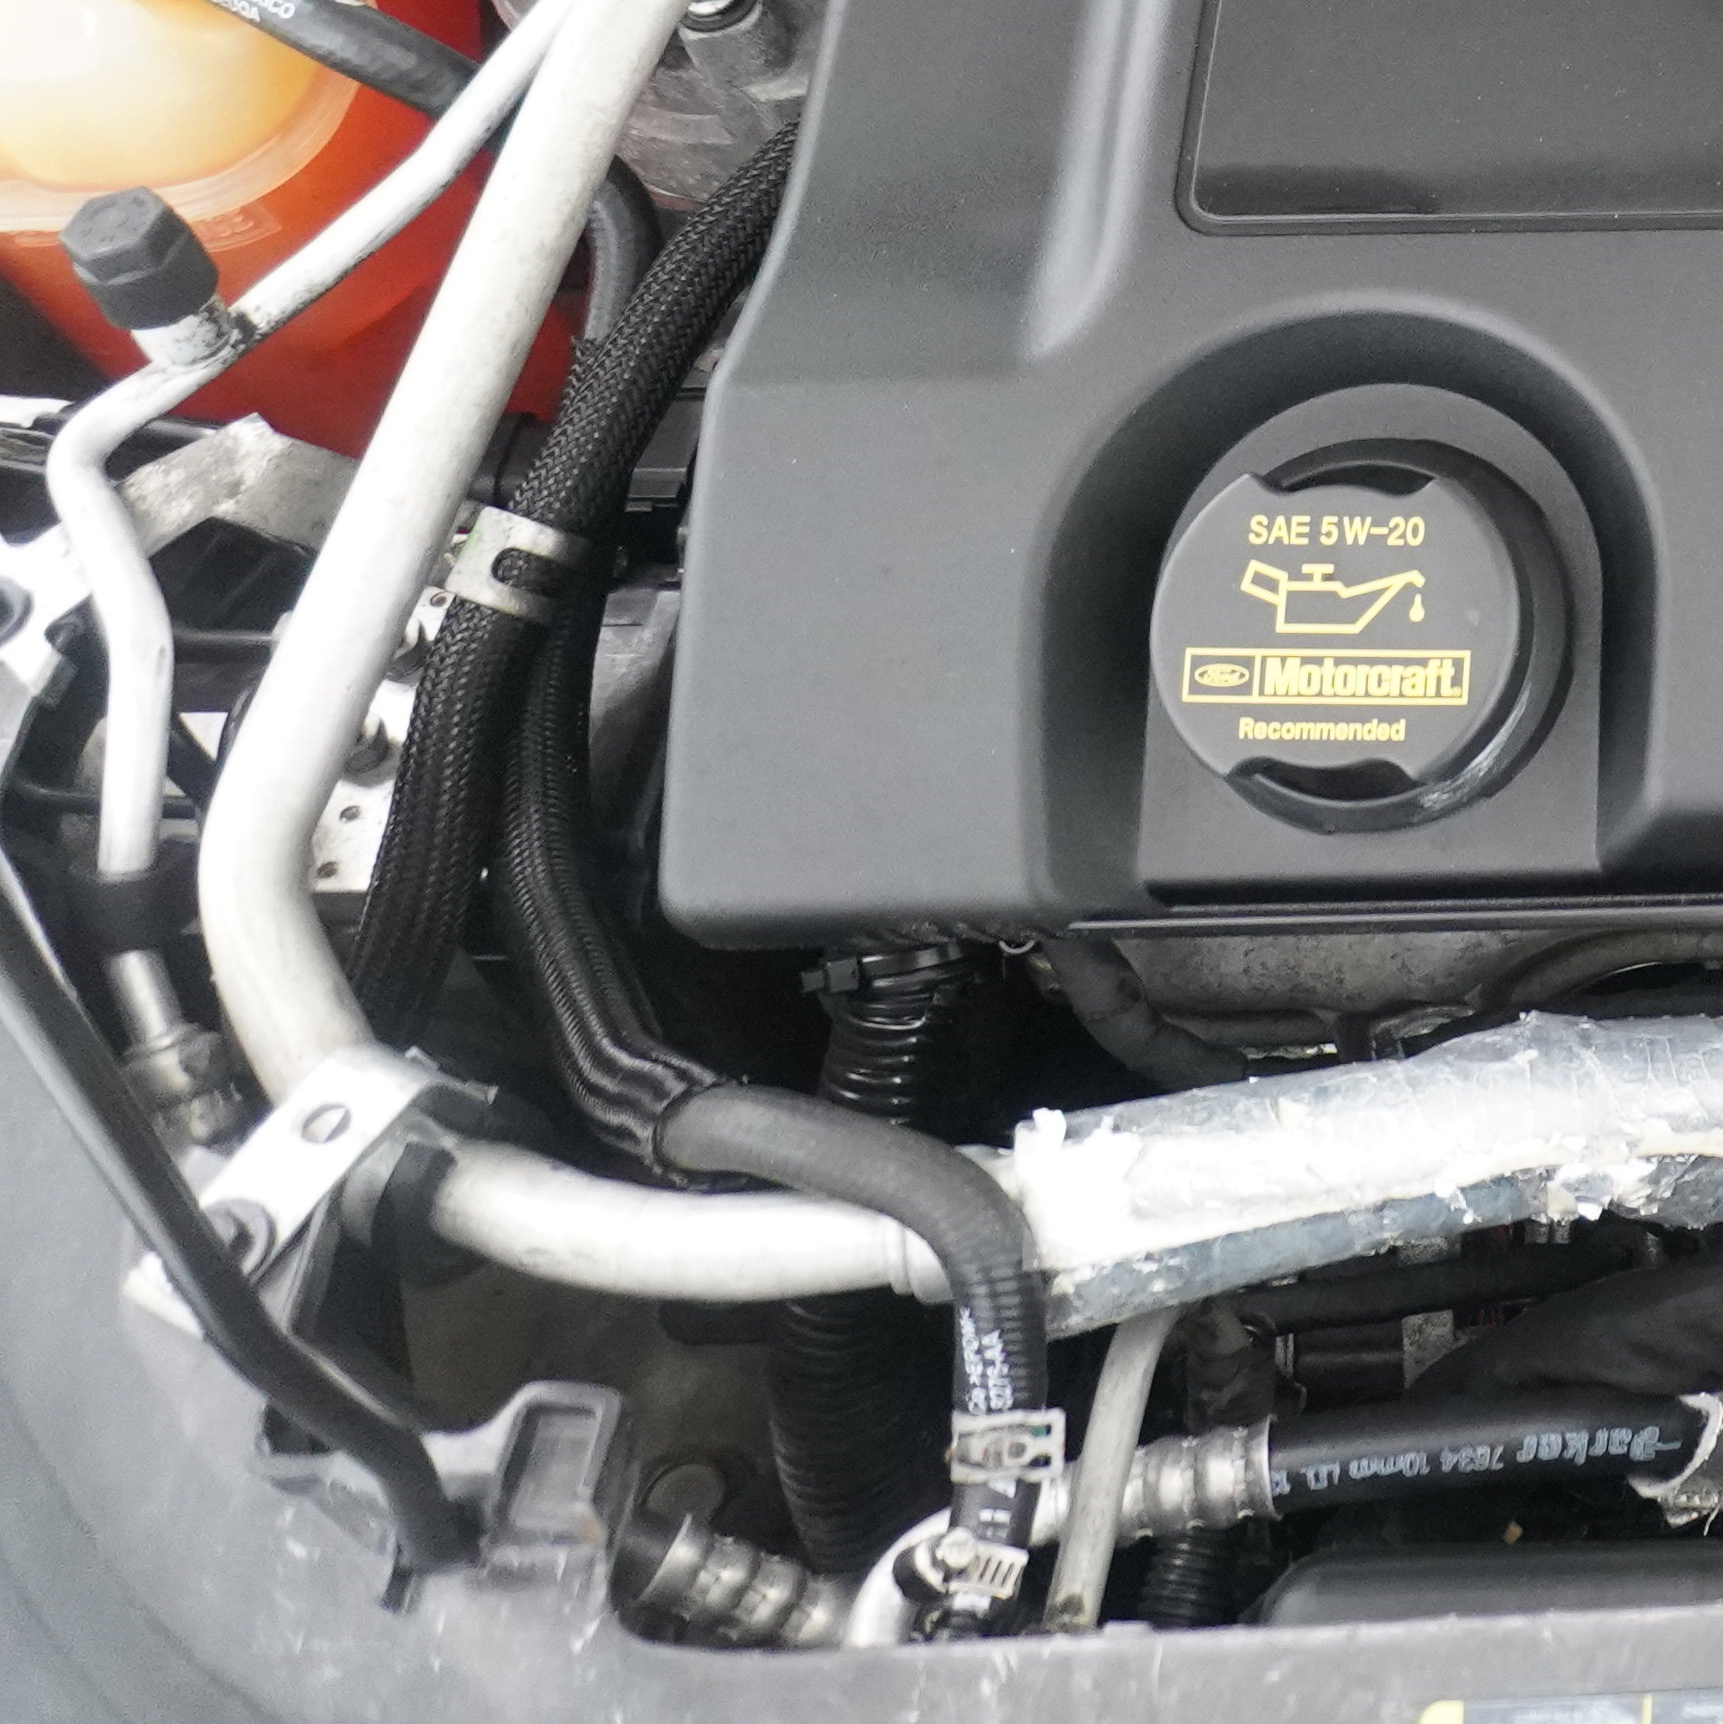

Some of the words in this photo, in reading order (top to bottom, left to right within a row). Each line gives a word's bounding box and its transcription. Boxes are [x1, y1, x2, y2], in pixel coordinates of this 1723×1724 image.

[1248, 516, 1309, 546] SAE
[1319, 515, 1425, 546] 5W-20
[1264, 657, 1462, 697] Motorcraft
[1239, 718, 1406, 742] Recommended
[1517, 1426, 1660, 1466] Parker
[1349, 1451, 1430, 1480] 10mm
